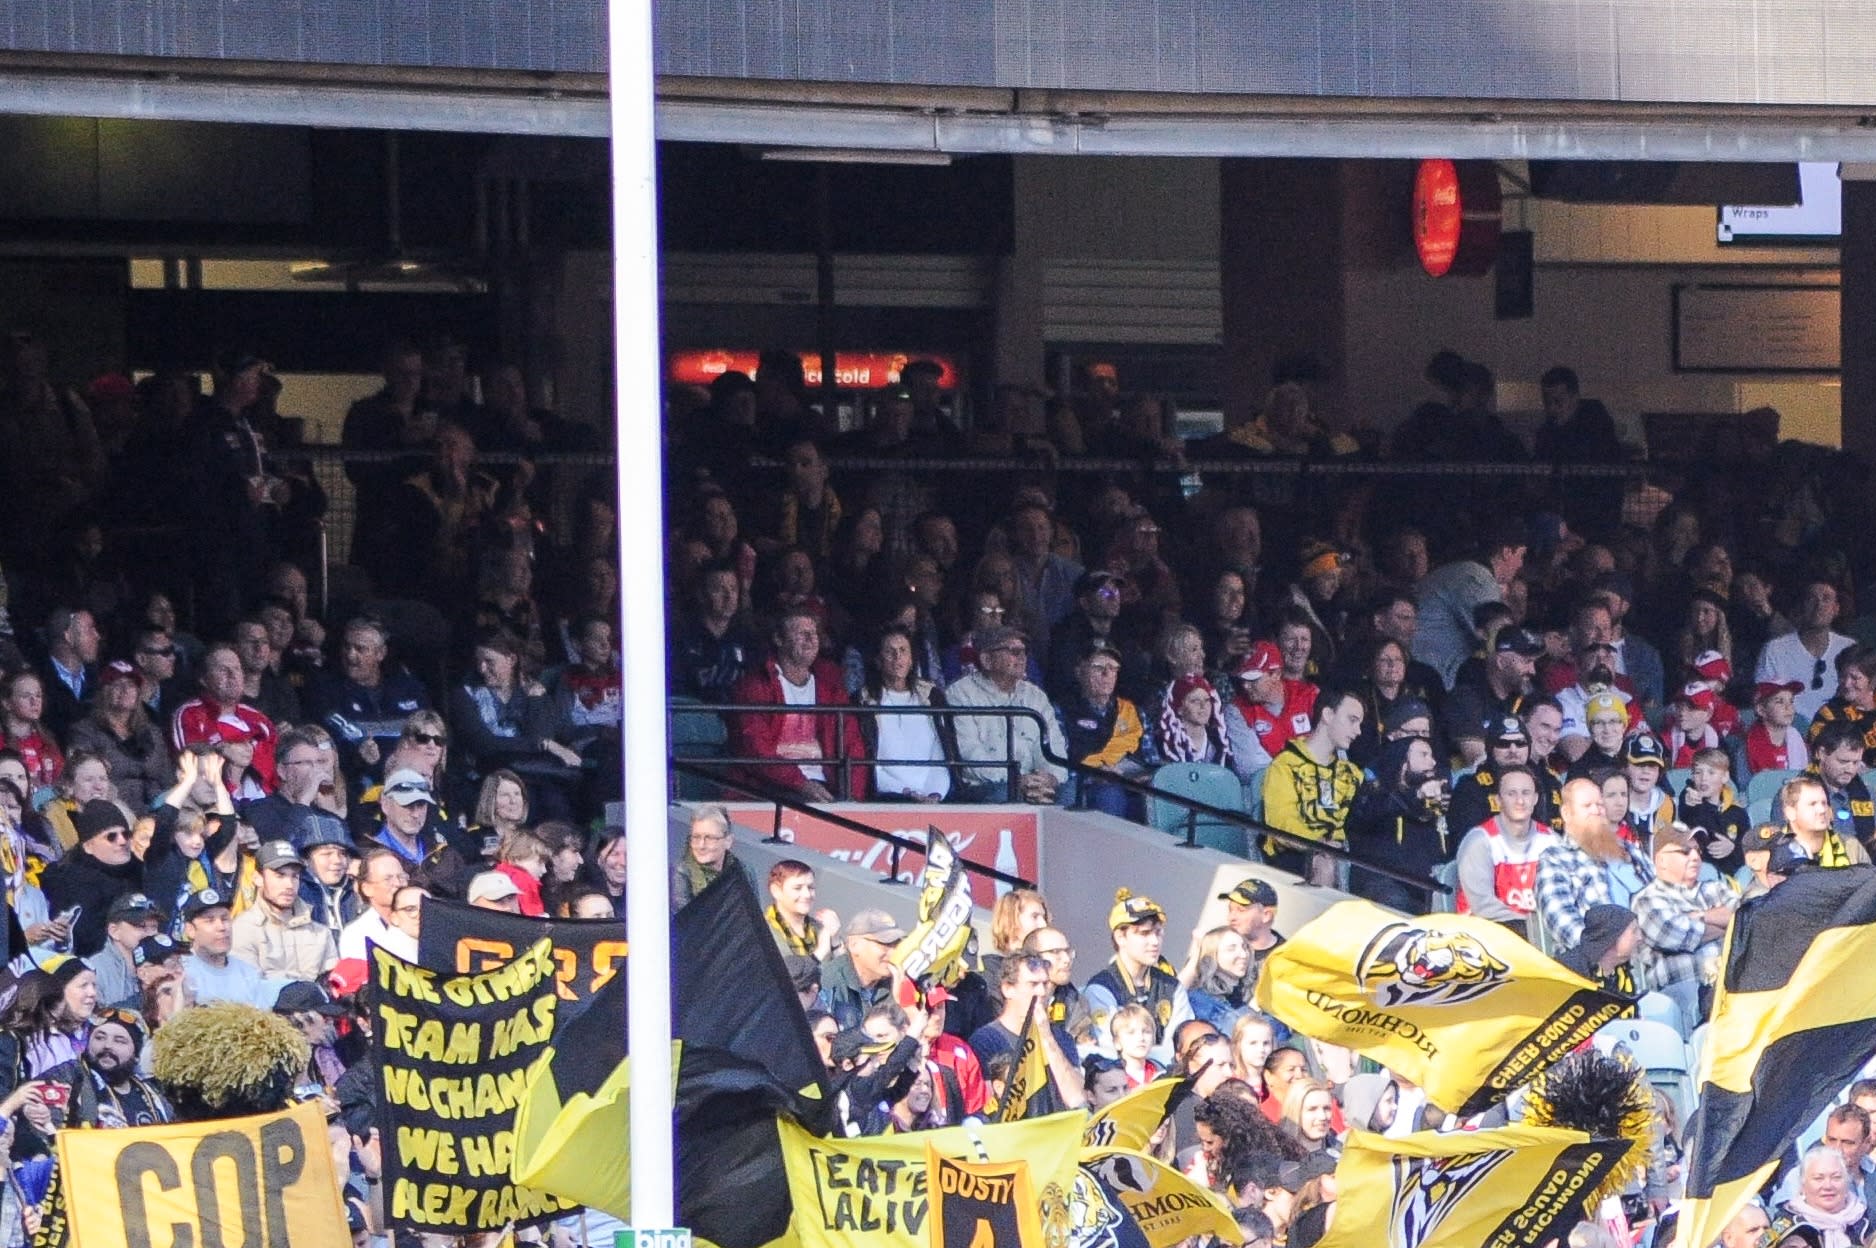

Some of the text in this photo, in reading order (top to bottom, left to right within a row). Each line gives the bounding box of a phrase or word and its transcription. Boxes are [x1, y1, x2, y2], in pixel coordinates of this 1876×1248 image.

[1732, 208, 1769, 219] Wraps
[371, 936, 556, 1008] THE OTHER
[378, 1002, 482, 1065] TEAM
[397, 1126, 460, 1175] WE
[391, 1177, 478, 1226] ALEX
[940, 1166, 1016, 1205] DUSTY
